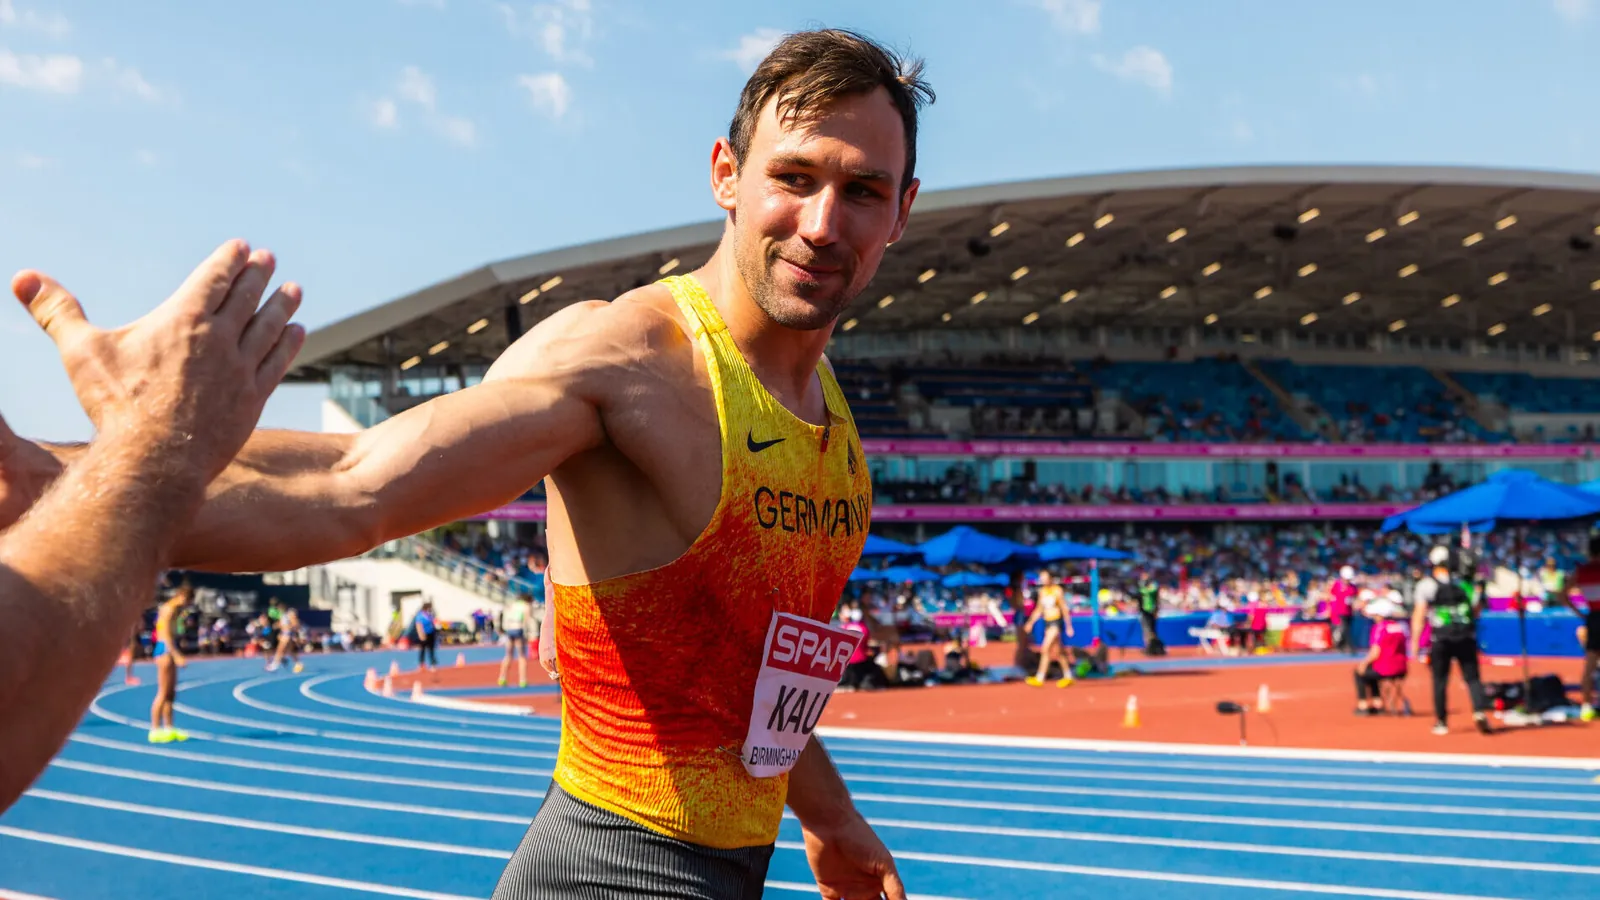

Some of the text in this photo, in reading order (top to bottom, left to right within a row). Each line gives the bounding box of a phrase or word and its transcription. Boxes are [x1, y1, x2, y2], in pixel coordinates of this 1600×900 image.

[755, 486, 869, 537] GERMANY
[773, 624, 855, 675] SPAR
[749, 746, 801, 767] BIRMINGHA
